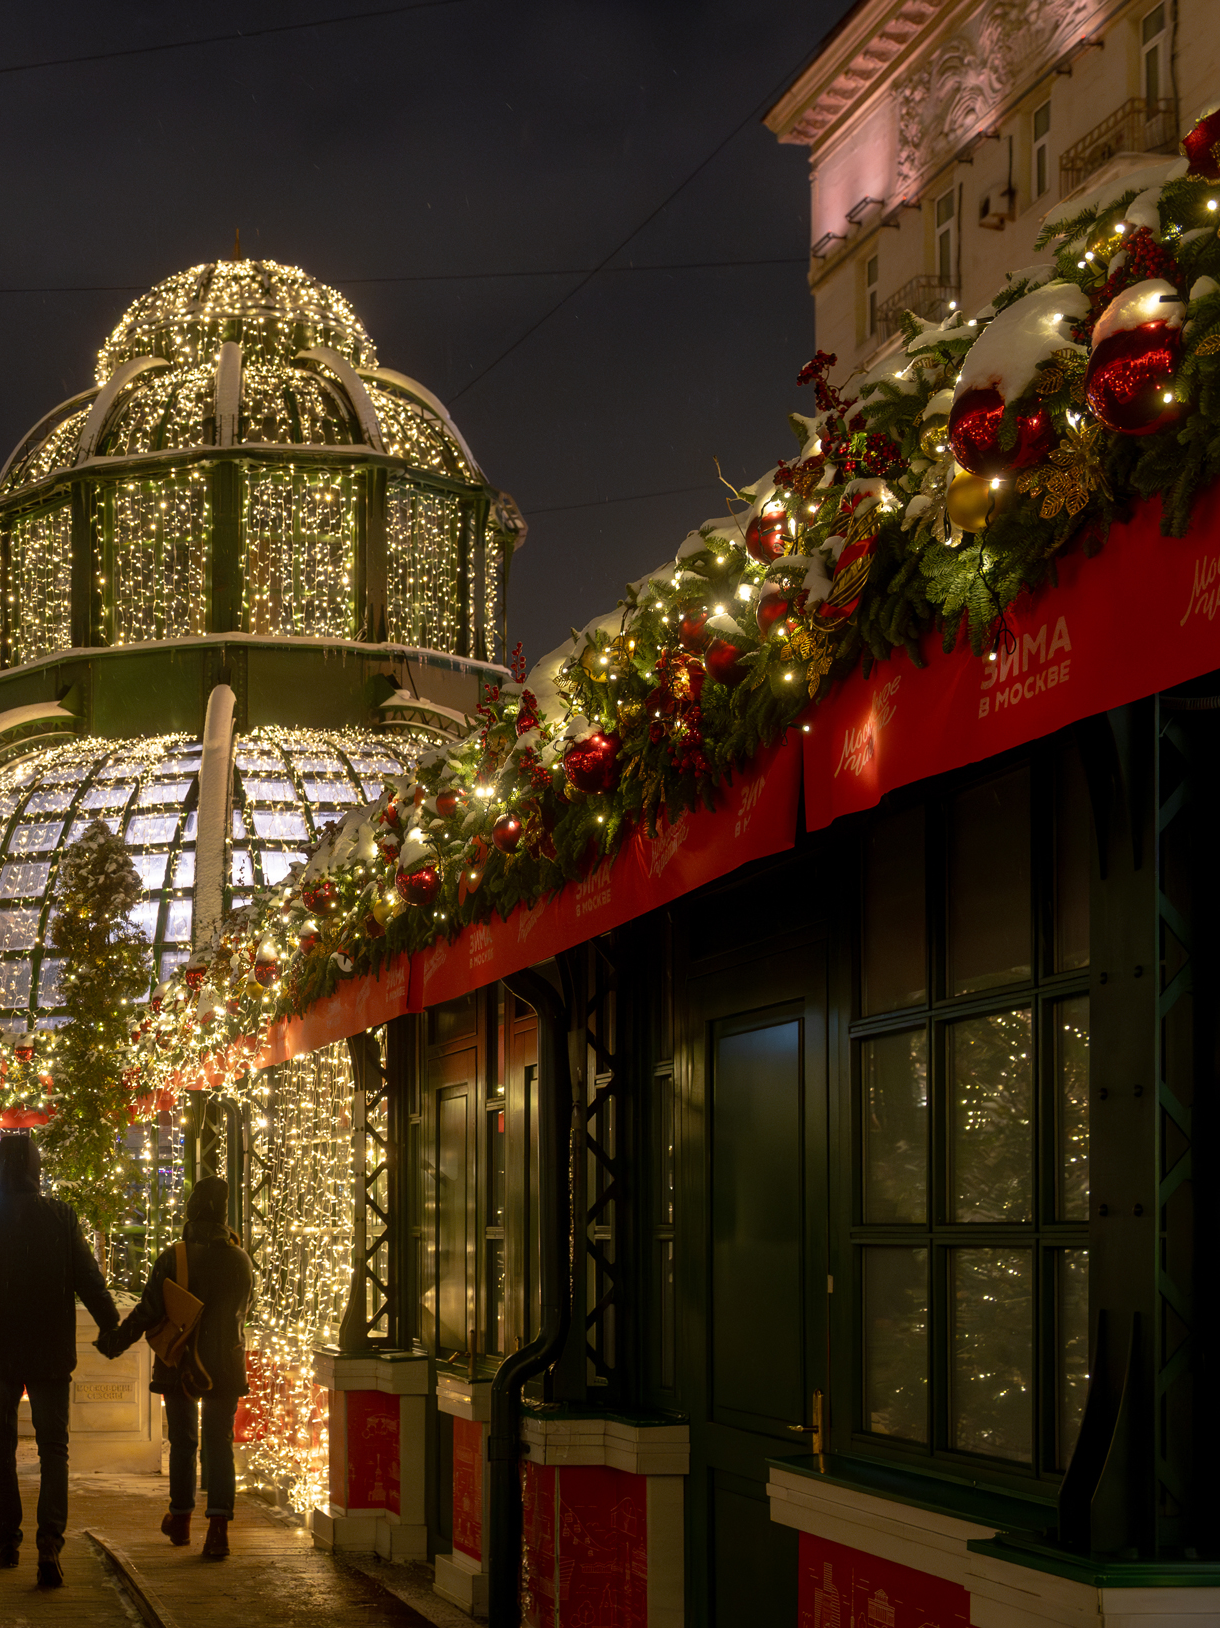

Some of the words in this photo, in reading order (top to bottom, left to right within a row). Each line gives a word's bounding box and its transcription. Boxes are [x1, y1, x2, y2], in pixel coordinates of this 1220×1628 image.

[980, 615, 1072, 691] ЗИМА
[978, 696, 990, 719] В
[994, 659, 1072, 712] МОСКВЕ
